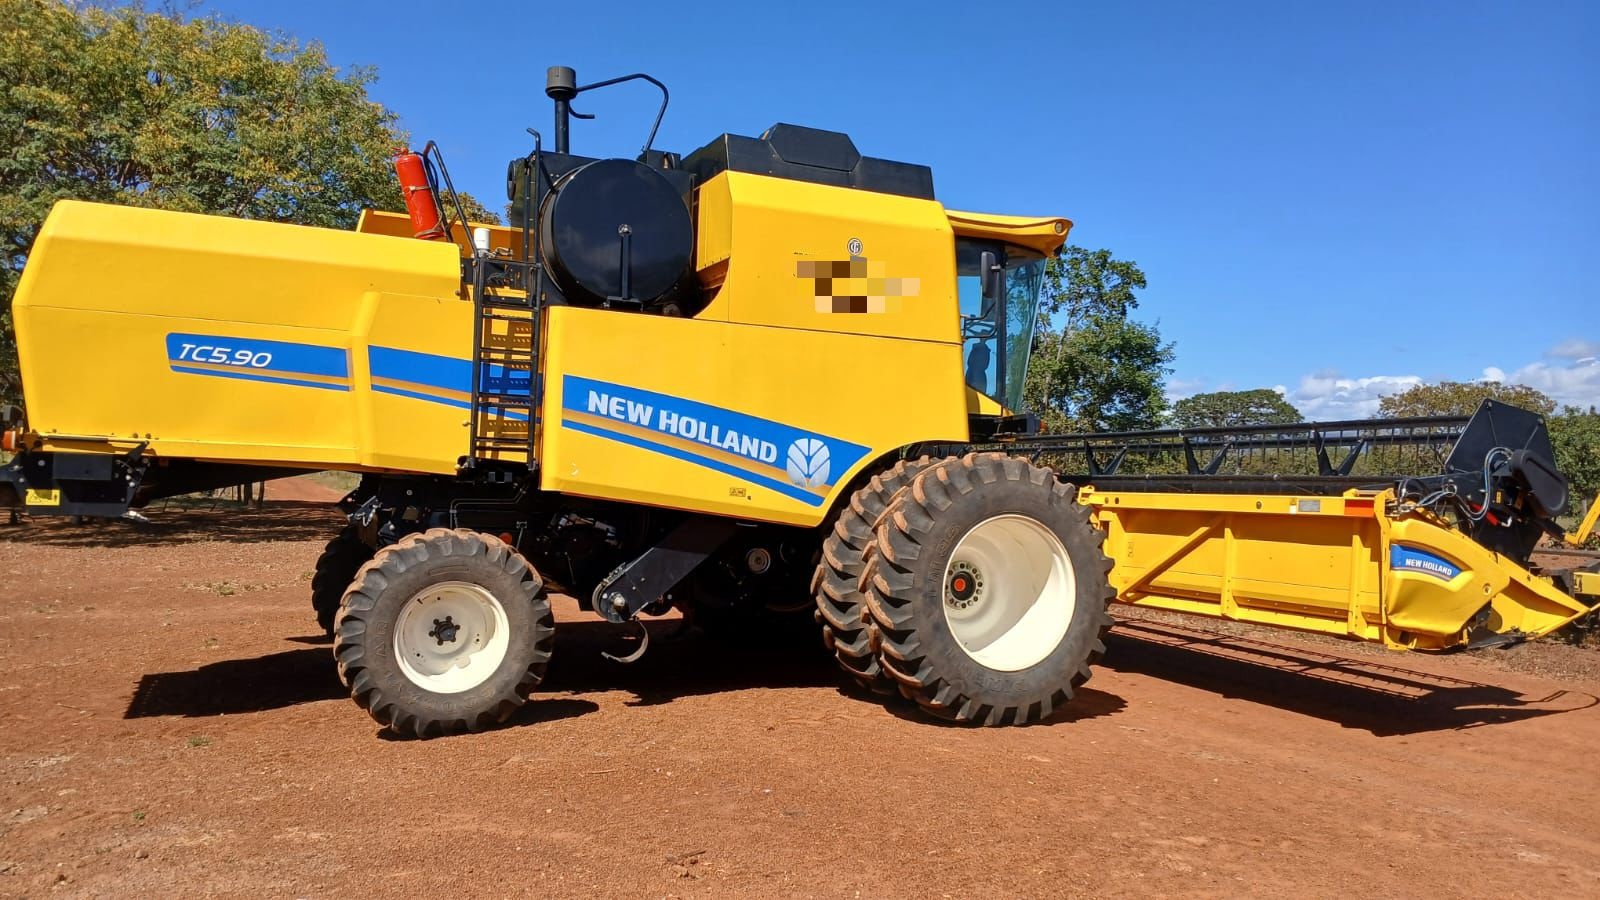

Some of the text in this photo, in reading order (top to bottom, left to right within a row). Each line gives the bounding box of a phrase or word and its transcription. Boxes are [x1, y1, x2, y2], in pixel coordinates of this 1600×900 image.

[179, 343, 273, 368] TC5.90
[587, 390, 778, 464] NEW HOLLAND
[1405, 558, 1453, 576] NEW HOLLAND
